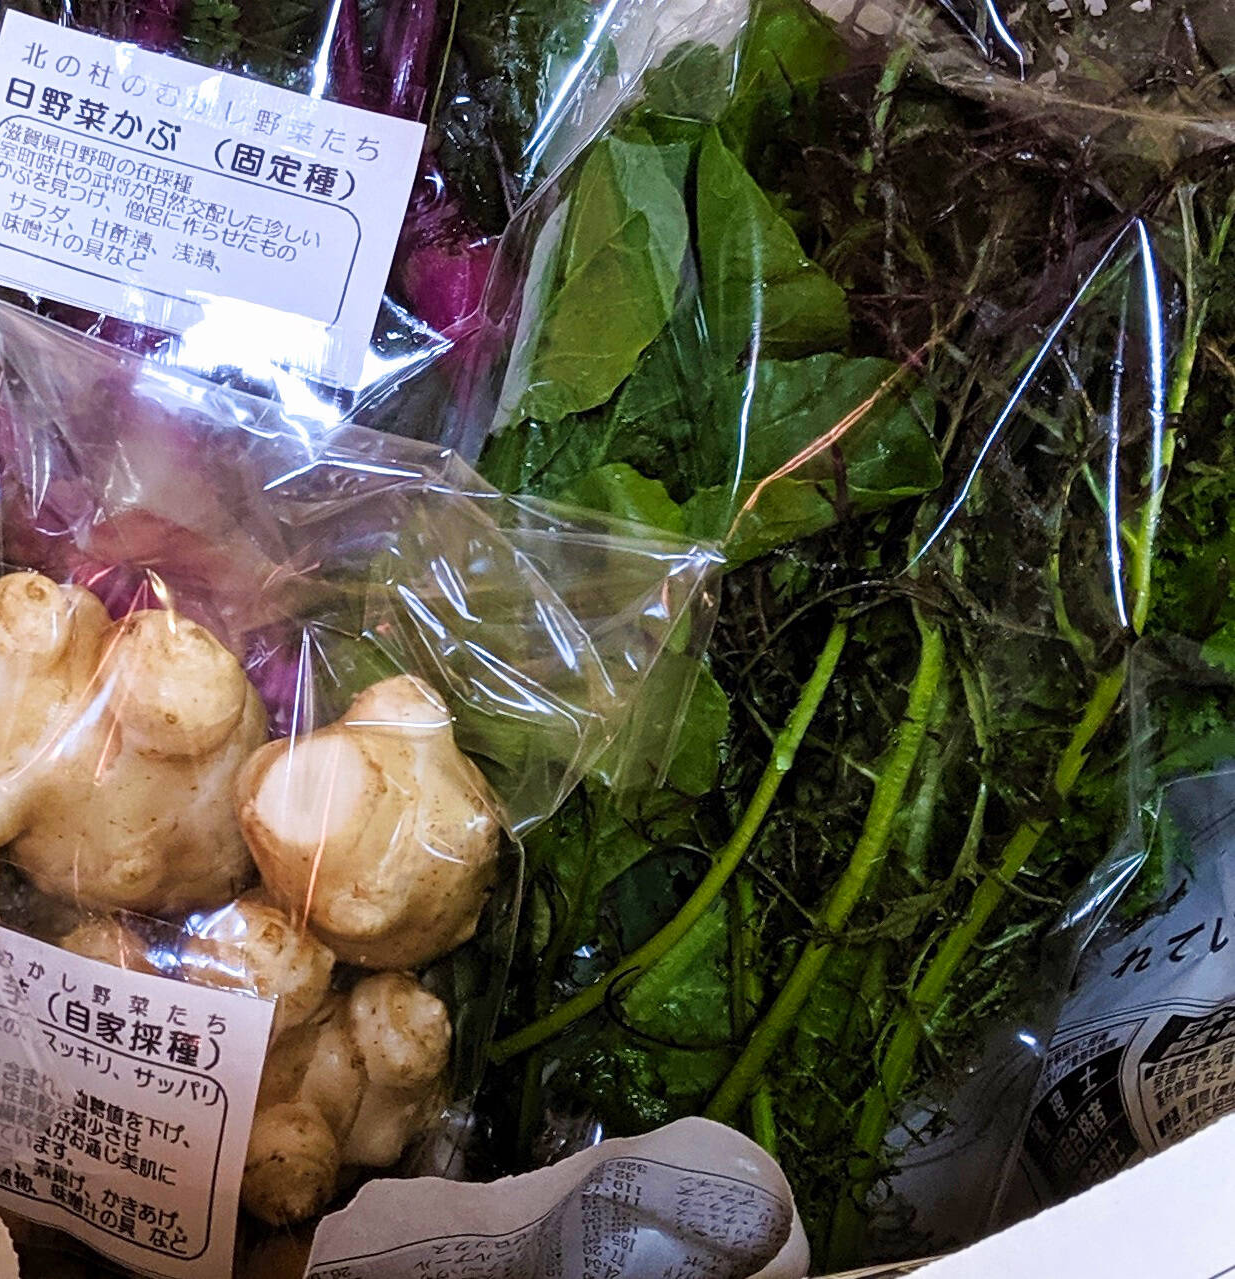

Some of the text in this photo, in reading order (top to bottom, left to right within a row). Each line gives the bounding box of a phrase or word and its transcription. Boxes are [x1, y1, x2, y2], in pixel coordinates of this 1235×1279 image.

[5, 77, 356, 201] 日野菜かぶ （固定種）
[1, 211, 146, 272] 味噌汁の具など
